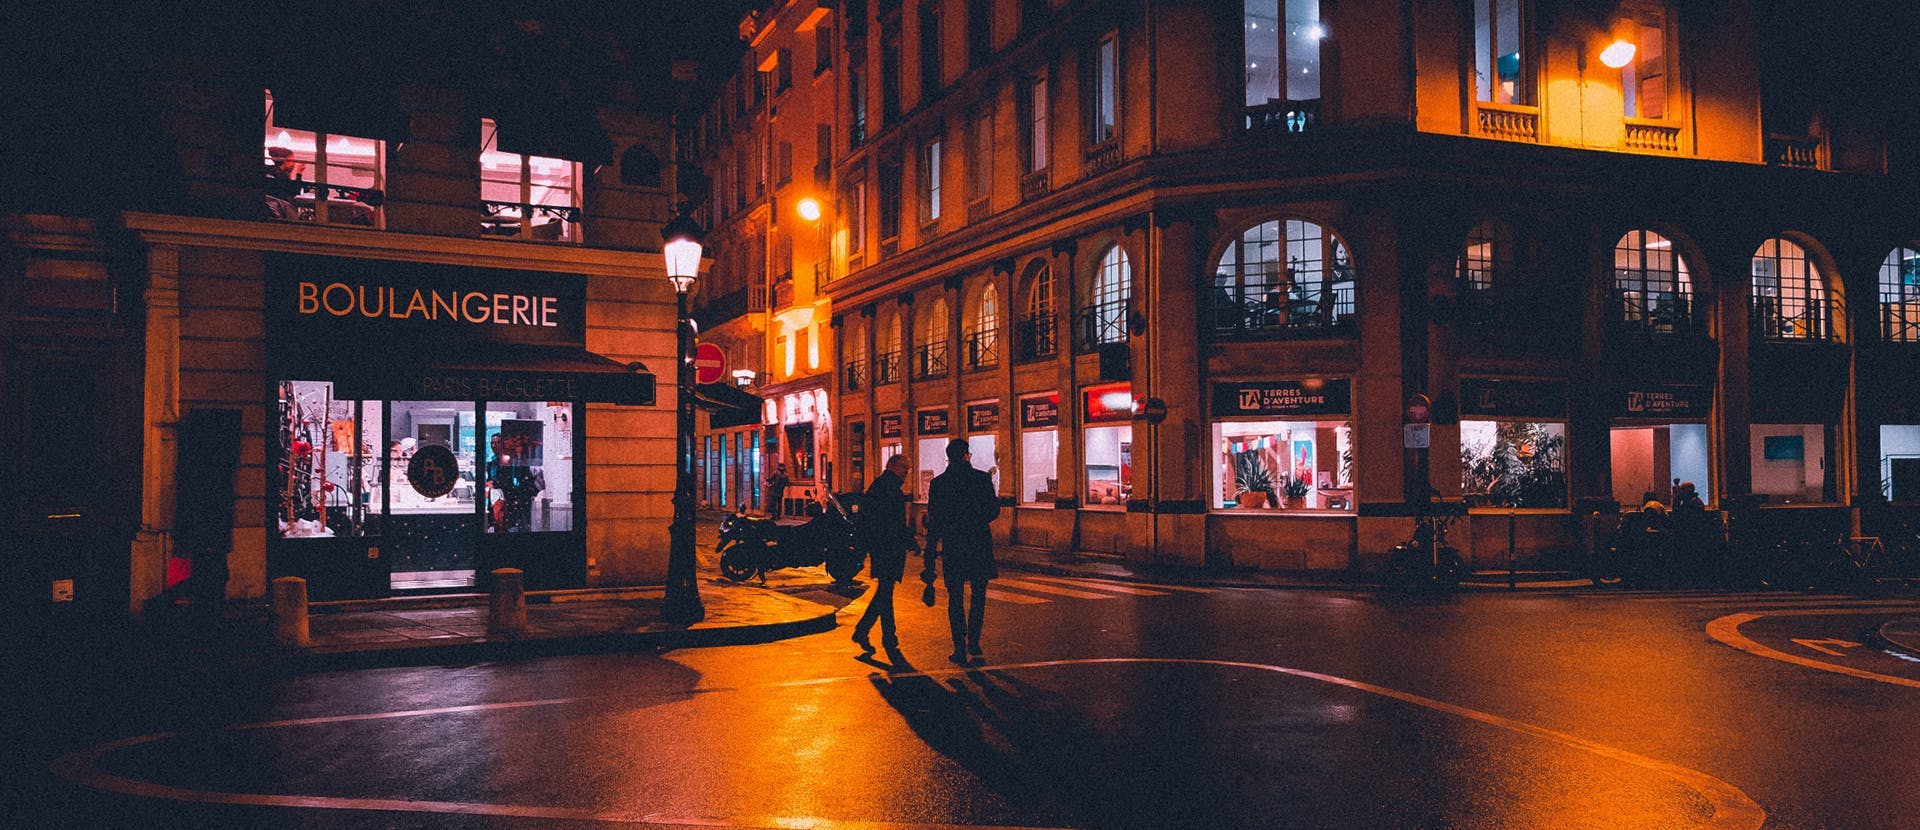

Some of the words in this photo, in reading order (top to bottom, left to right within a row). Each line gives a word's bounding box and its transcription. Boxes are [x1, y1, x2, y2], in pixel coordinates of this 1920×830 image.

[299, 281, 558, 327] BOULANGERIE
[422, 376, 473, 397] PARIS
[479, 377, 578, 399] BAGUETTE
[1264, 389, 1301, 397] TERRES
[1240, 390, 1260, 409] TA
[1263, 396, 1324, 405] D'AVENTURE
